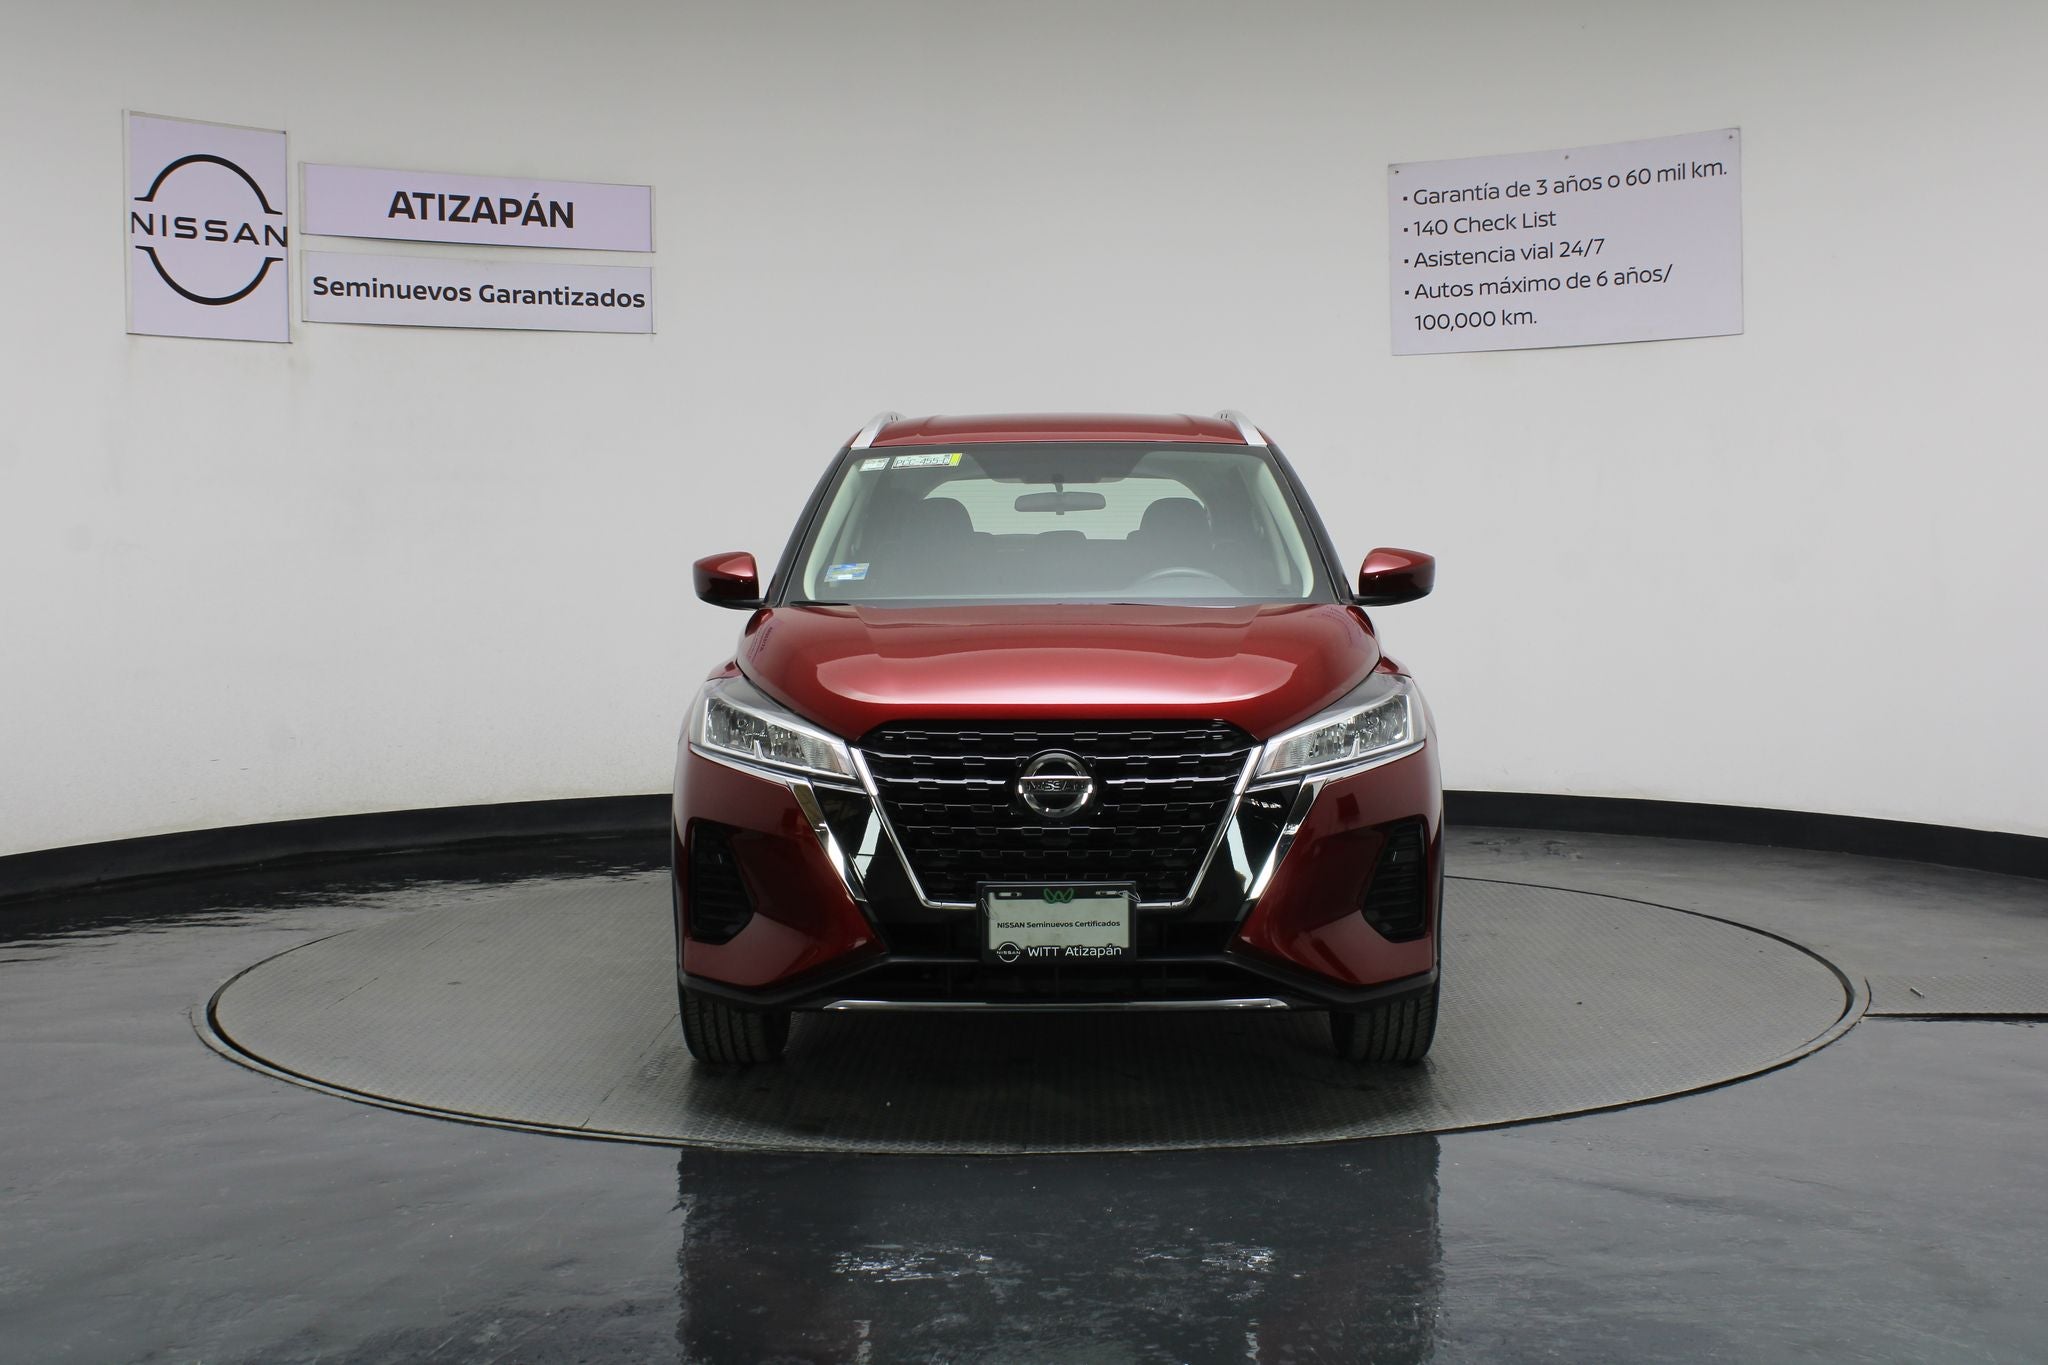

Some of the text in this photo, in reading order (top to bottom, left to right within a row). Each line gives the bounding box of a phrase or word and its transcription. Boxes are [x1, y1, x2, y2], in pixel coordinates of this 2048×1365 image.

[1414, 160, 1728, 206] Garantía de 3 años o 60 mil km.
[388, 191, 574, 229] ATIZAPÁN
[1414, 210, 1557, 237] 140 Check List
[131, 211, 288, 247] NISSAN
[1414, 238, 1606, 269] Asistencia vial 24/7
[313, 276, 646, 309] Seminuevos Garantizados
[1415, 264, 1674, 300] Autos máximo de 6 años/
[1415, 309, 1538, 333] 100,000 km.
[996, 920, 1121, 929] NISSAN Seminuevos Certificados
[1027, 946, 1060, 957] WITT
[1064, 943, 1122, 959] Atizapán
